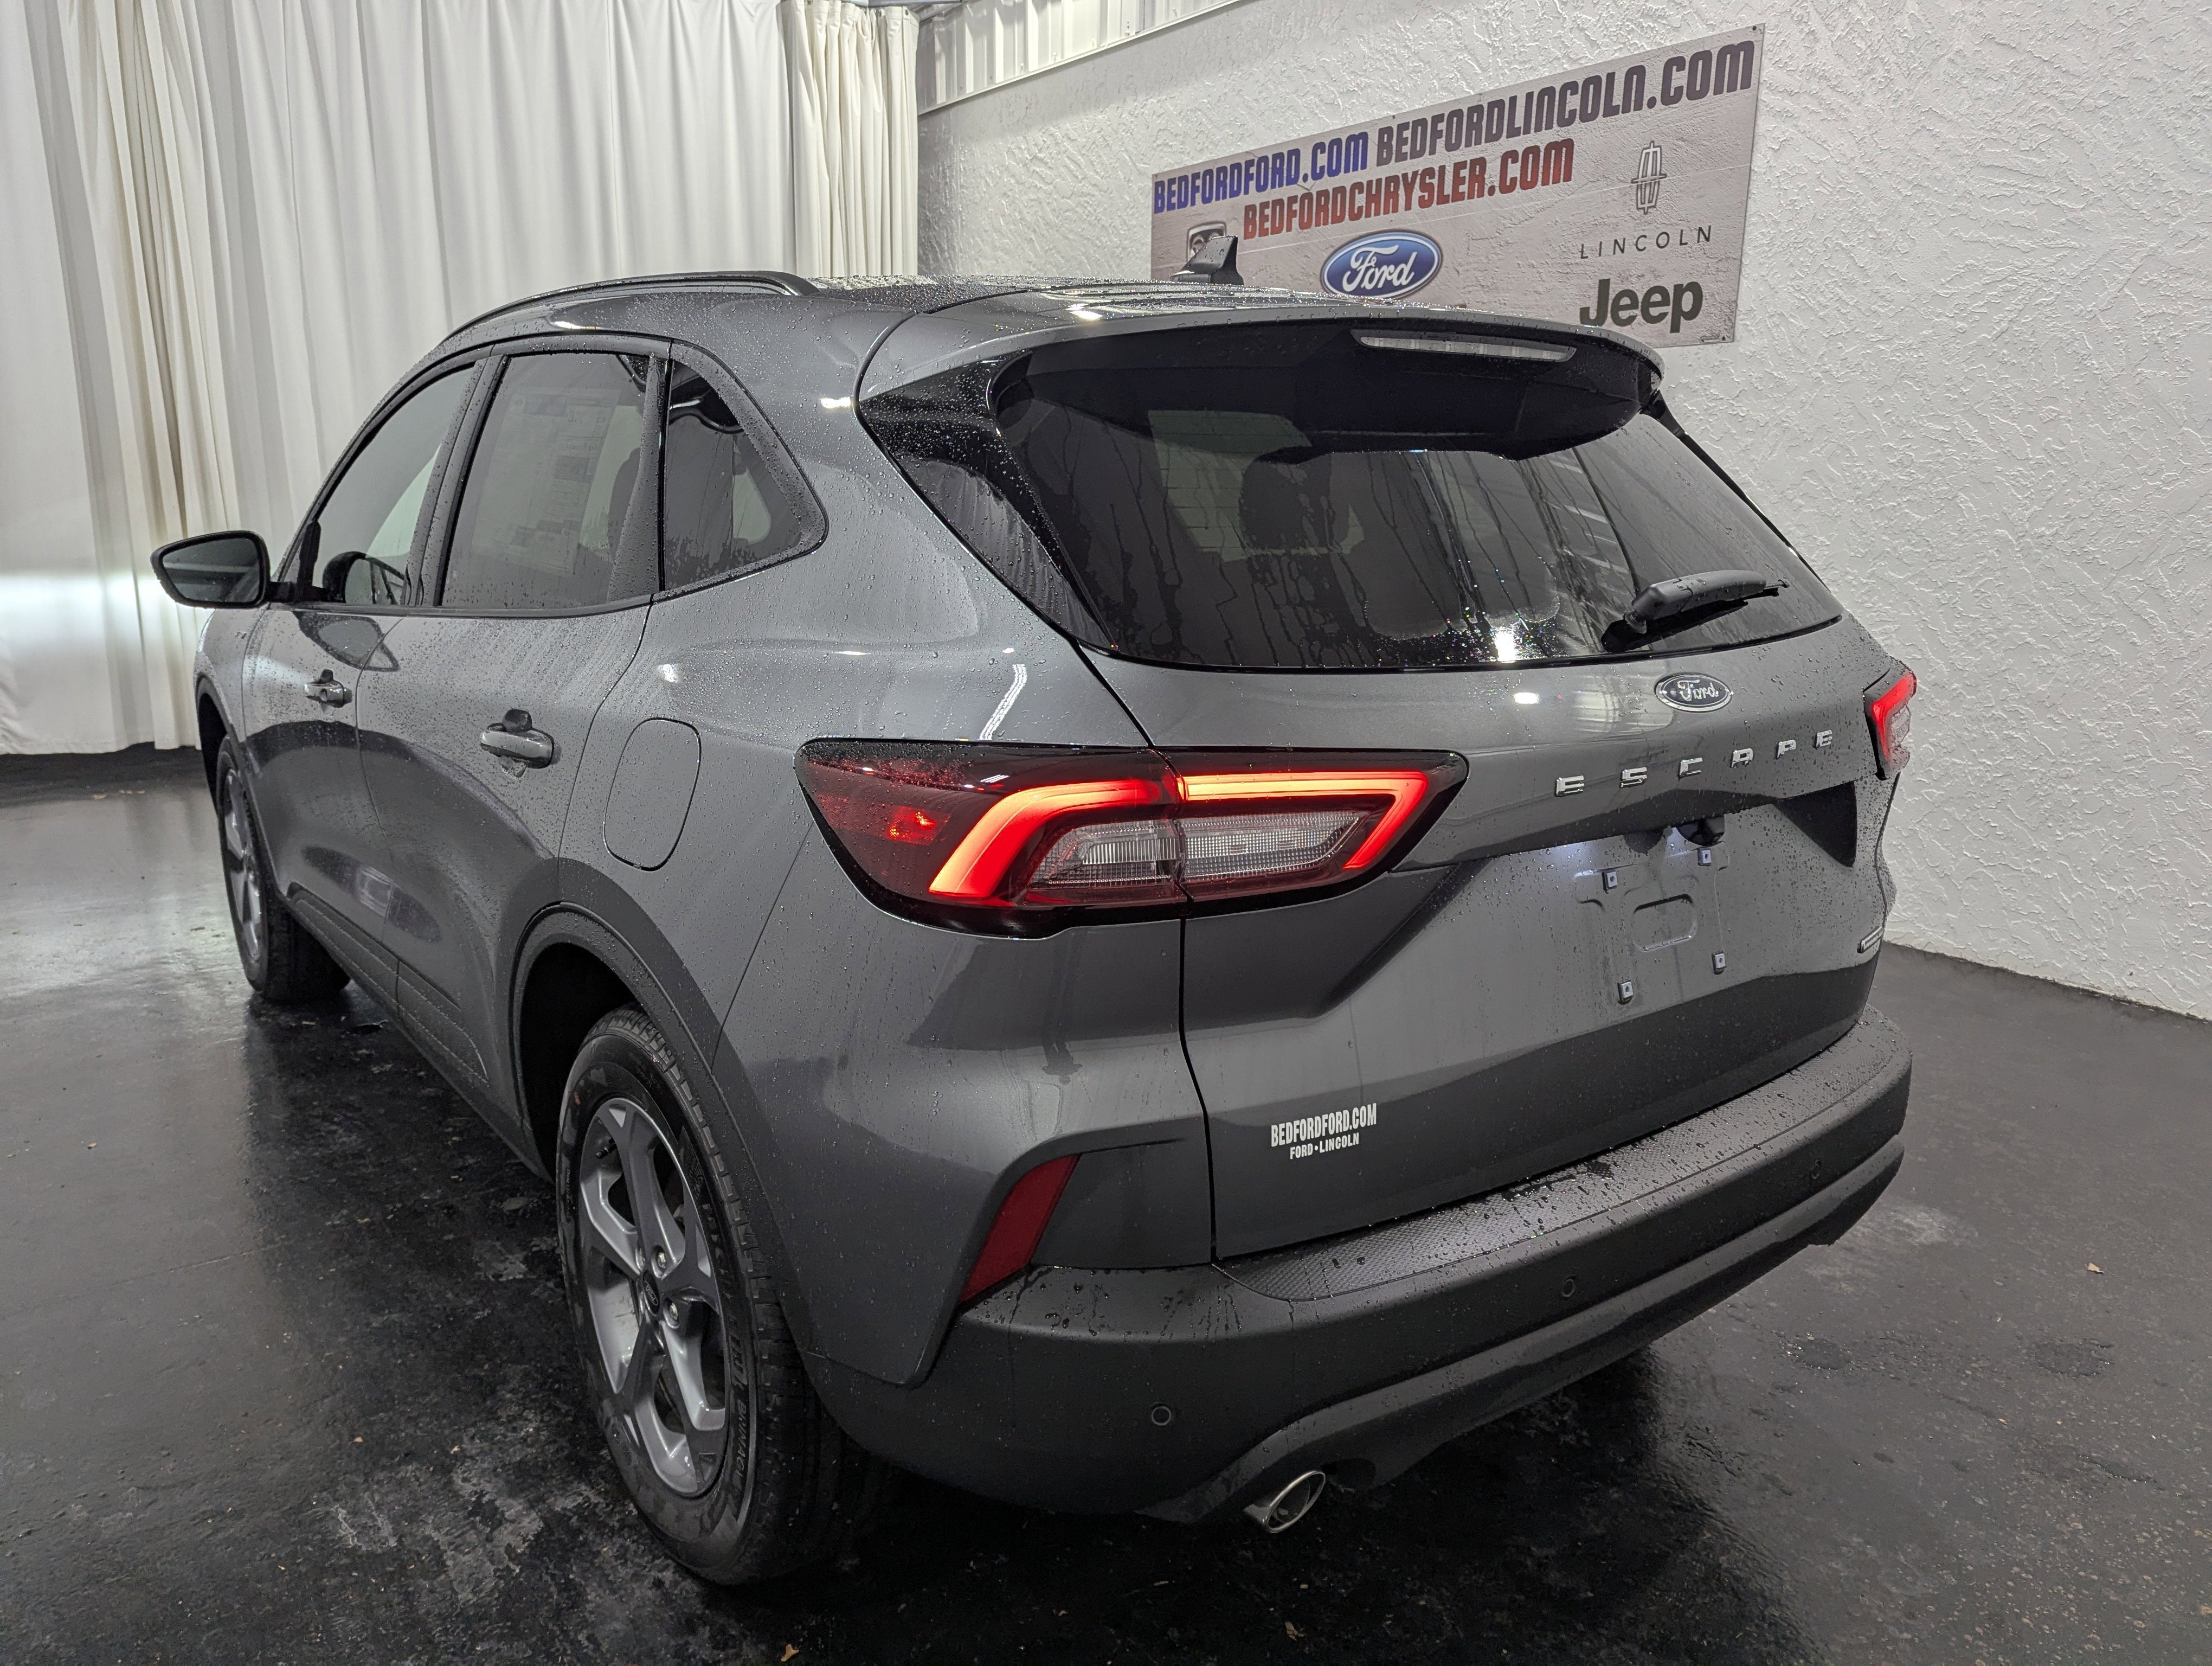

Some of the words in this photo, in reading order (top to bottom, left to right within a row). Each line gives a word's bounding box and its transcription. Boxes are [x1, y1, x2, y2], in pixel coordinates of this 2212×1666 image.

[1154, 131, 1368, 214] BEDFORDFORD.COM
[1376, 40, 1754, 166] BEDFORDLINCOLN.COM
[1244, 138, 1574, 240] BEDFORDCHRYSLER.COM
[1342, 244, 1418, 292] Ford
[1580, 225, 1712, 259] LINCOLN
[1579, 278, 1703, 334] Jeep
[1677, 679, 1719, 701] Ford
[1555, 729, 1832, 797] ESCAPE
[1271, 1103, 1377, 1148] BEDFORDFORD.COM
